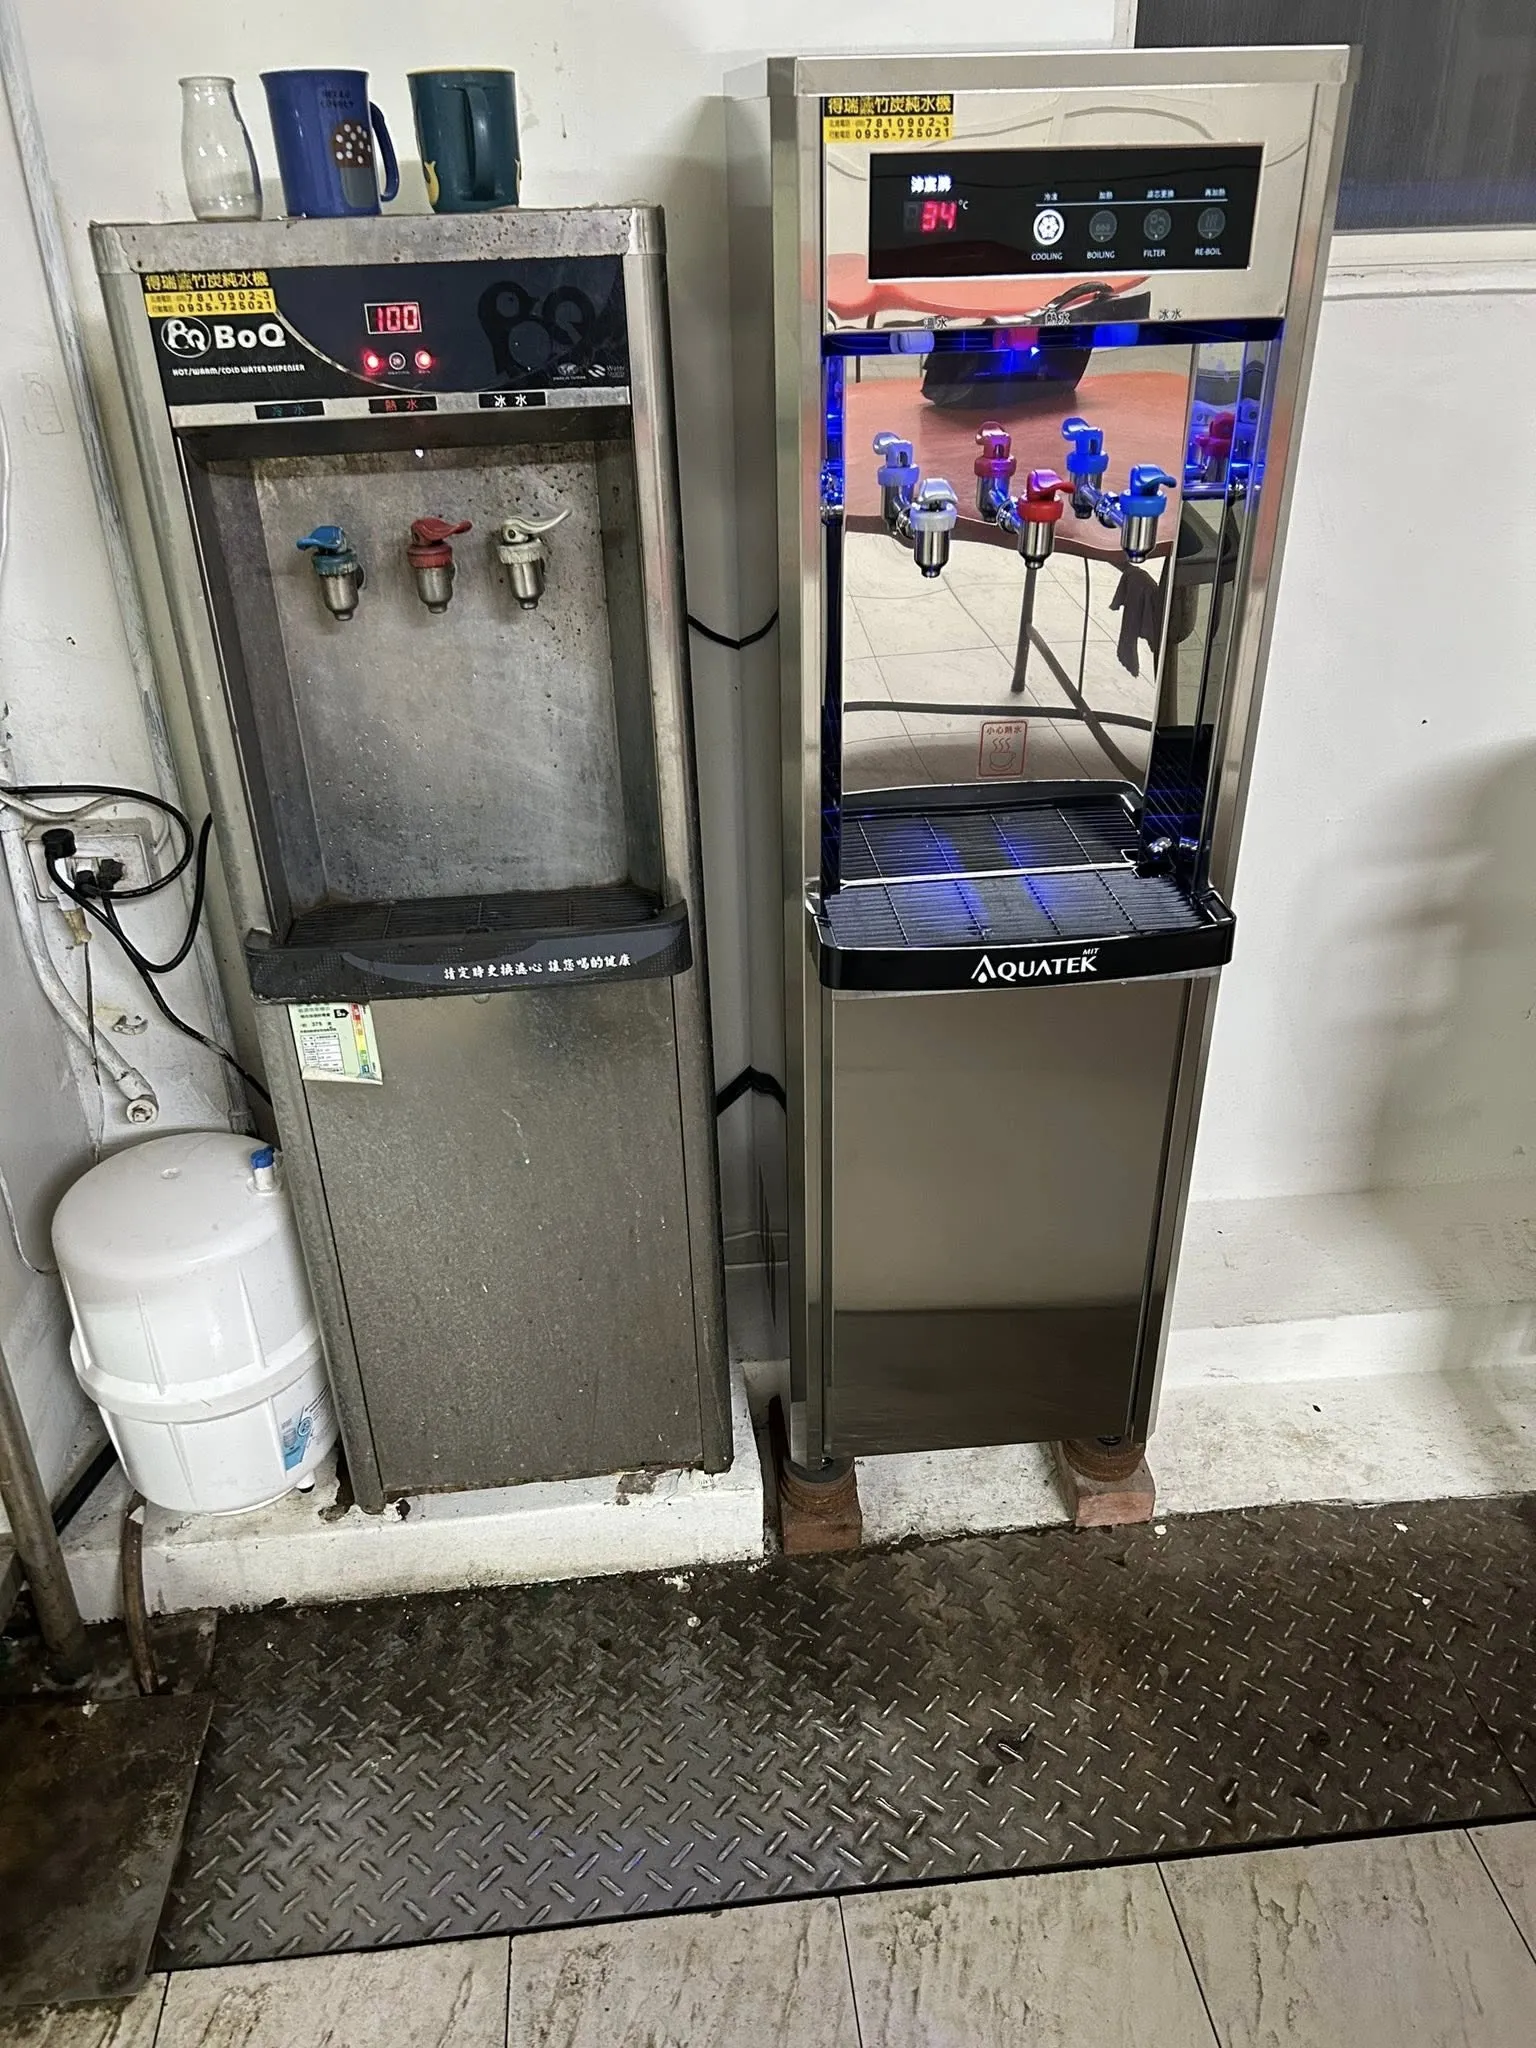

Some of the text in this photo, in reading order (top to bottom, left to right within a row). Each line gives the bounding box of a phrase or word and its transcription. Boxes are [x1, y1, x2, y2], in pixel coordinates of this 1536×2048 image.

[855, 128, 950, 139] 0935-725021
[1031, 252, 1063, 261] COOLING
[1086, 250, 1116, 259] BOILING
[1143, 249, 1166, 258] FILTER
[178, 301, 272, 313] 0935-725021
[377, 305, 418, 332] 100
[1158, 308, 1183, 321] 冰水
[213, 322, 287, 349] BoQ
[241, 365, 267, 374] WATER
[267, 363, 306, 373] DISPENSER
[1083, 948, 1100, 956] MIT
[970, 954, 1098, 984] AQUATEK
